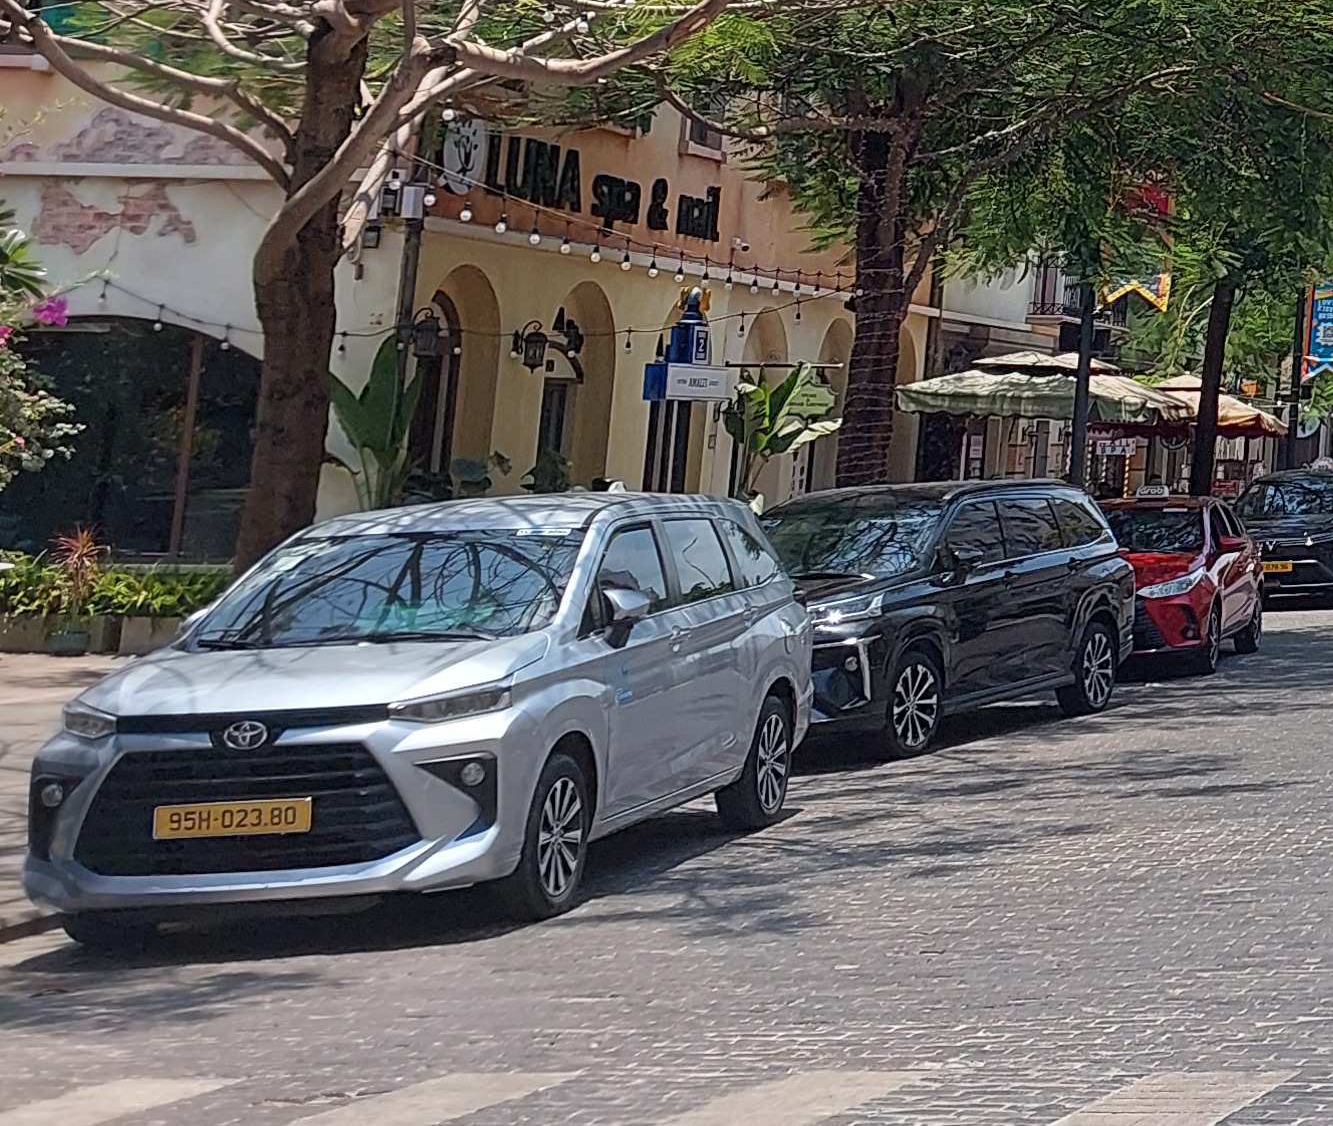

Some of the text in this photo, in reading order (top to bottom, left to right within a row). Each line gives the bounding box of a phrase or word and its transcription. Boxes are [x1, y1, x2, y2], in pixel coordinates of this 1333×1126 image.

[484, 132, 582, 214] LUNA
[590, 174, 641, 238] spa
[647, 178, 669, 231] &
[697, 339, 705, 353] 2
[1138, 486, 1164, 496] Grab
[169, 805, 297, 832] 95H-023.80
